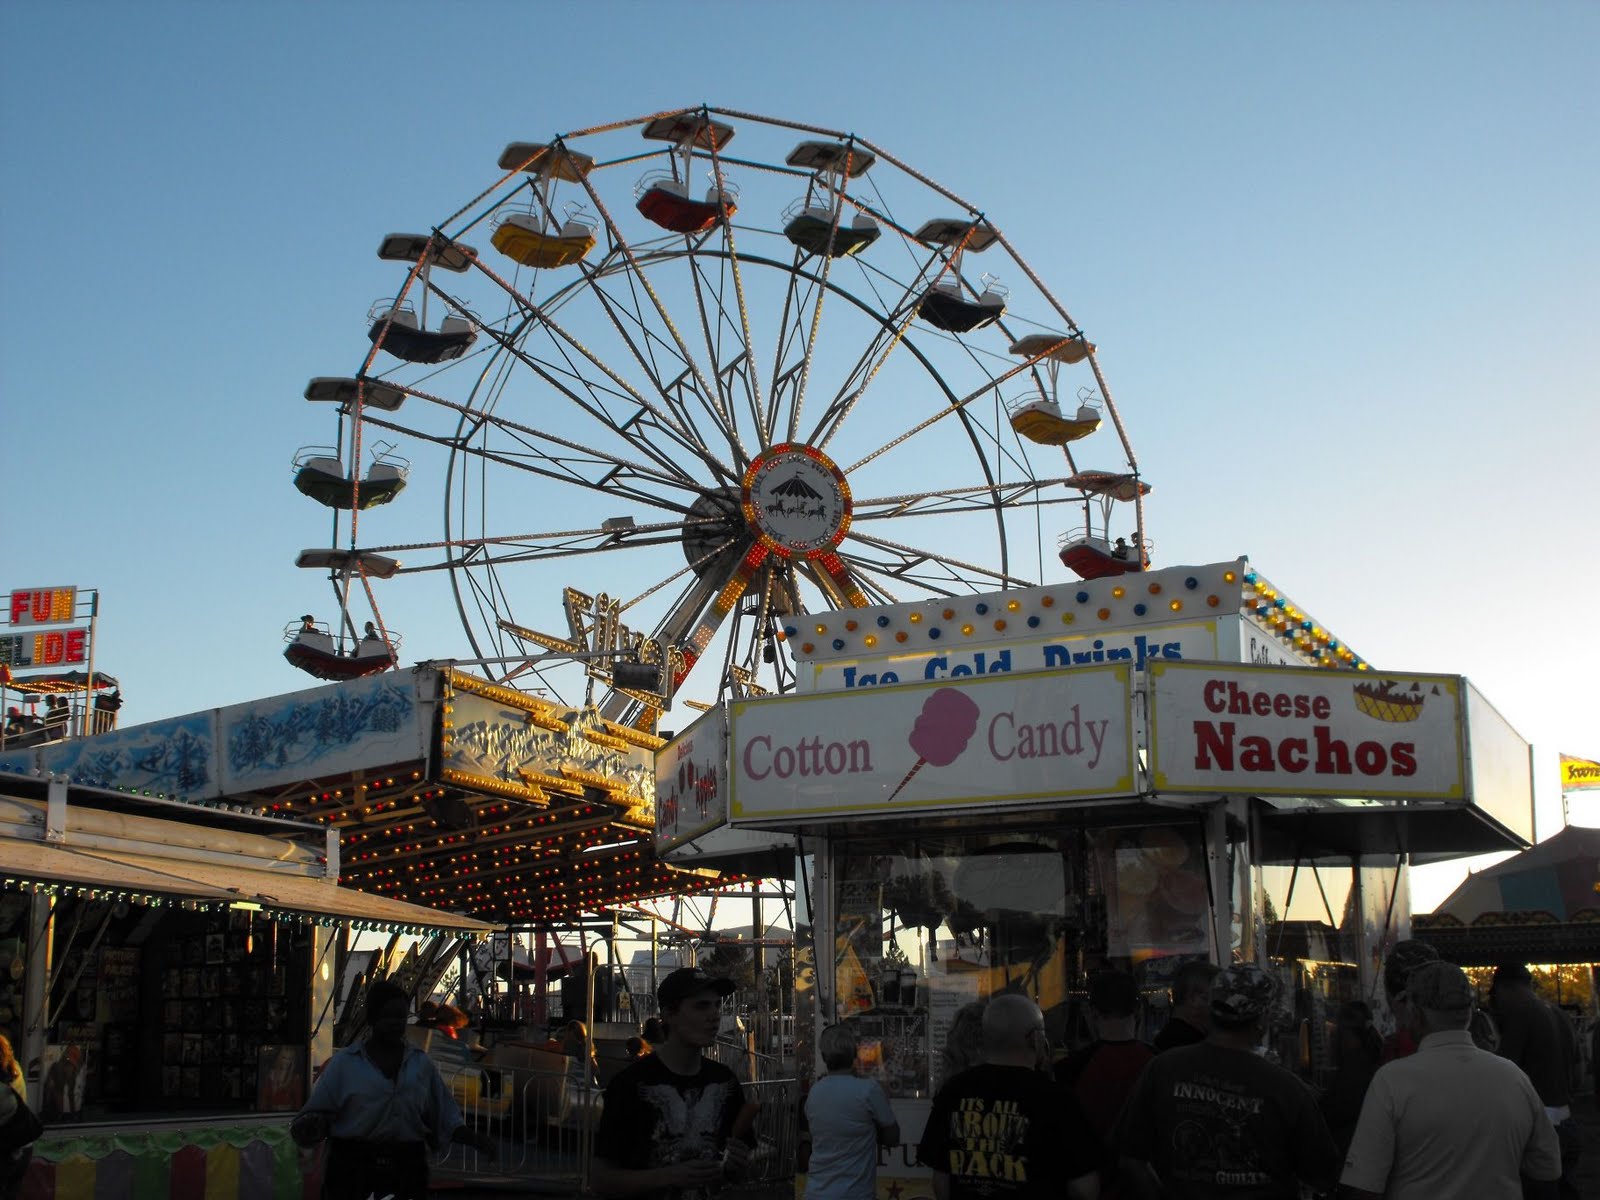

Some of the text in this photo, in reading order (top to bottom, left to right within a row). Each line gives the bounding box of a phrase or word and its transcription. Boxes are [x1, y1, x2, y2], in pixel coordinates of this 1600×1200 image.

[11, 588, 73, 624] FUN
[1203, 679, 1331, 720] Cheese
[743, 703, 1109, 781] Cotton Candy
[1193, 720, 1417, 777] Nachos
[1173, 1080, 1264, 1114] INNOCENT
